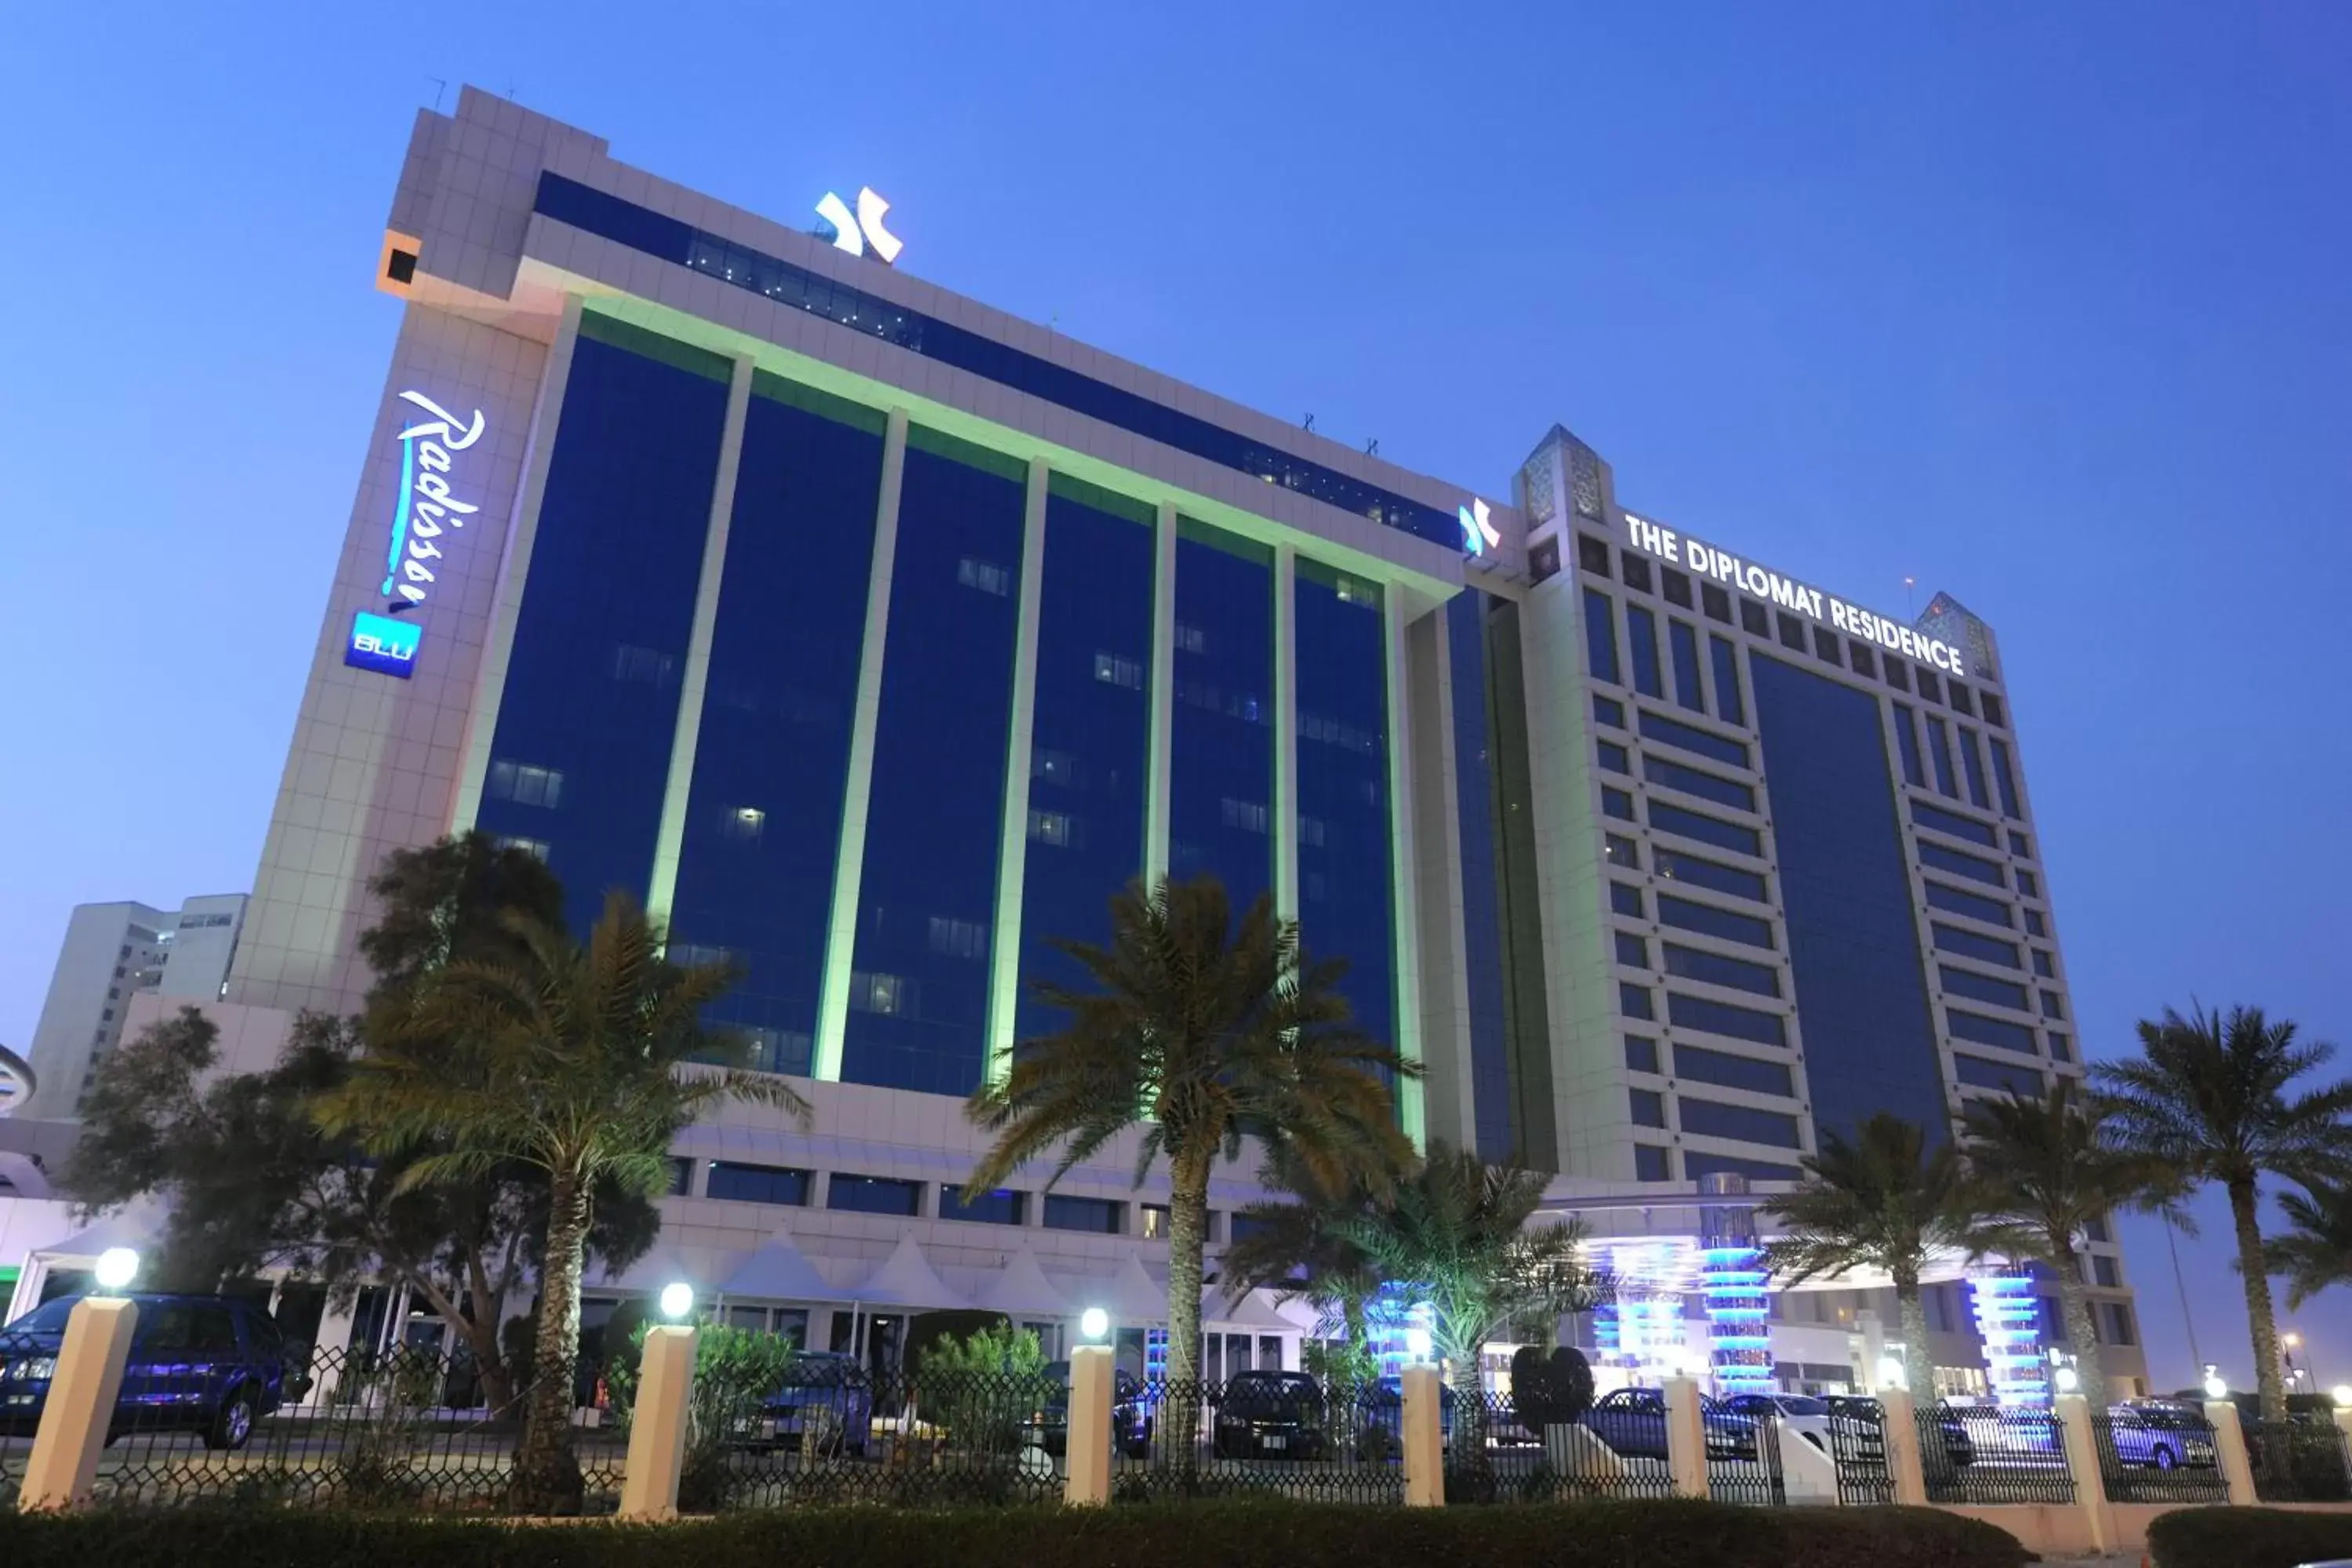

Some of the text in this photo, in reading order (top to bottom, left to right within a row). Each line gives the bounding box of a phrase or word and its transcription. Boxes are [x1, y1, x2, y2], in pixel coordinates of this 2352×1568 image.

[390, 390, 485, 613] Radisson
[354, 633, 413, 661] BLU
[1625, 514, 1964, 676] THE DIPLOMAT RESIDENCE
